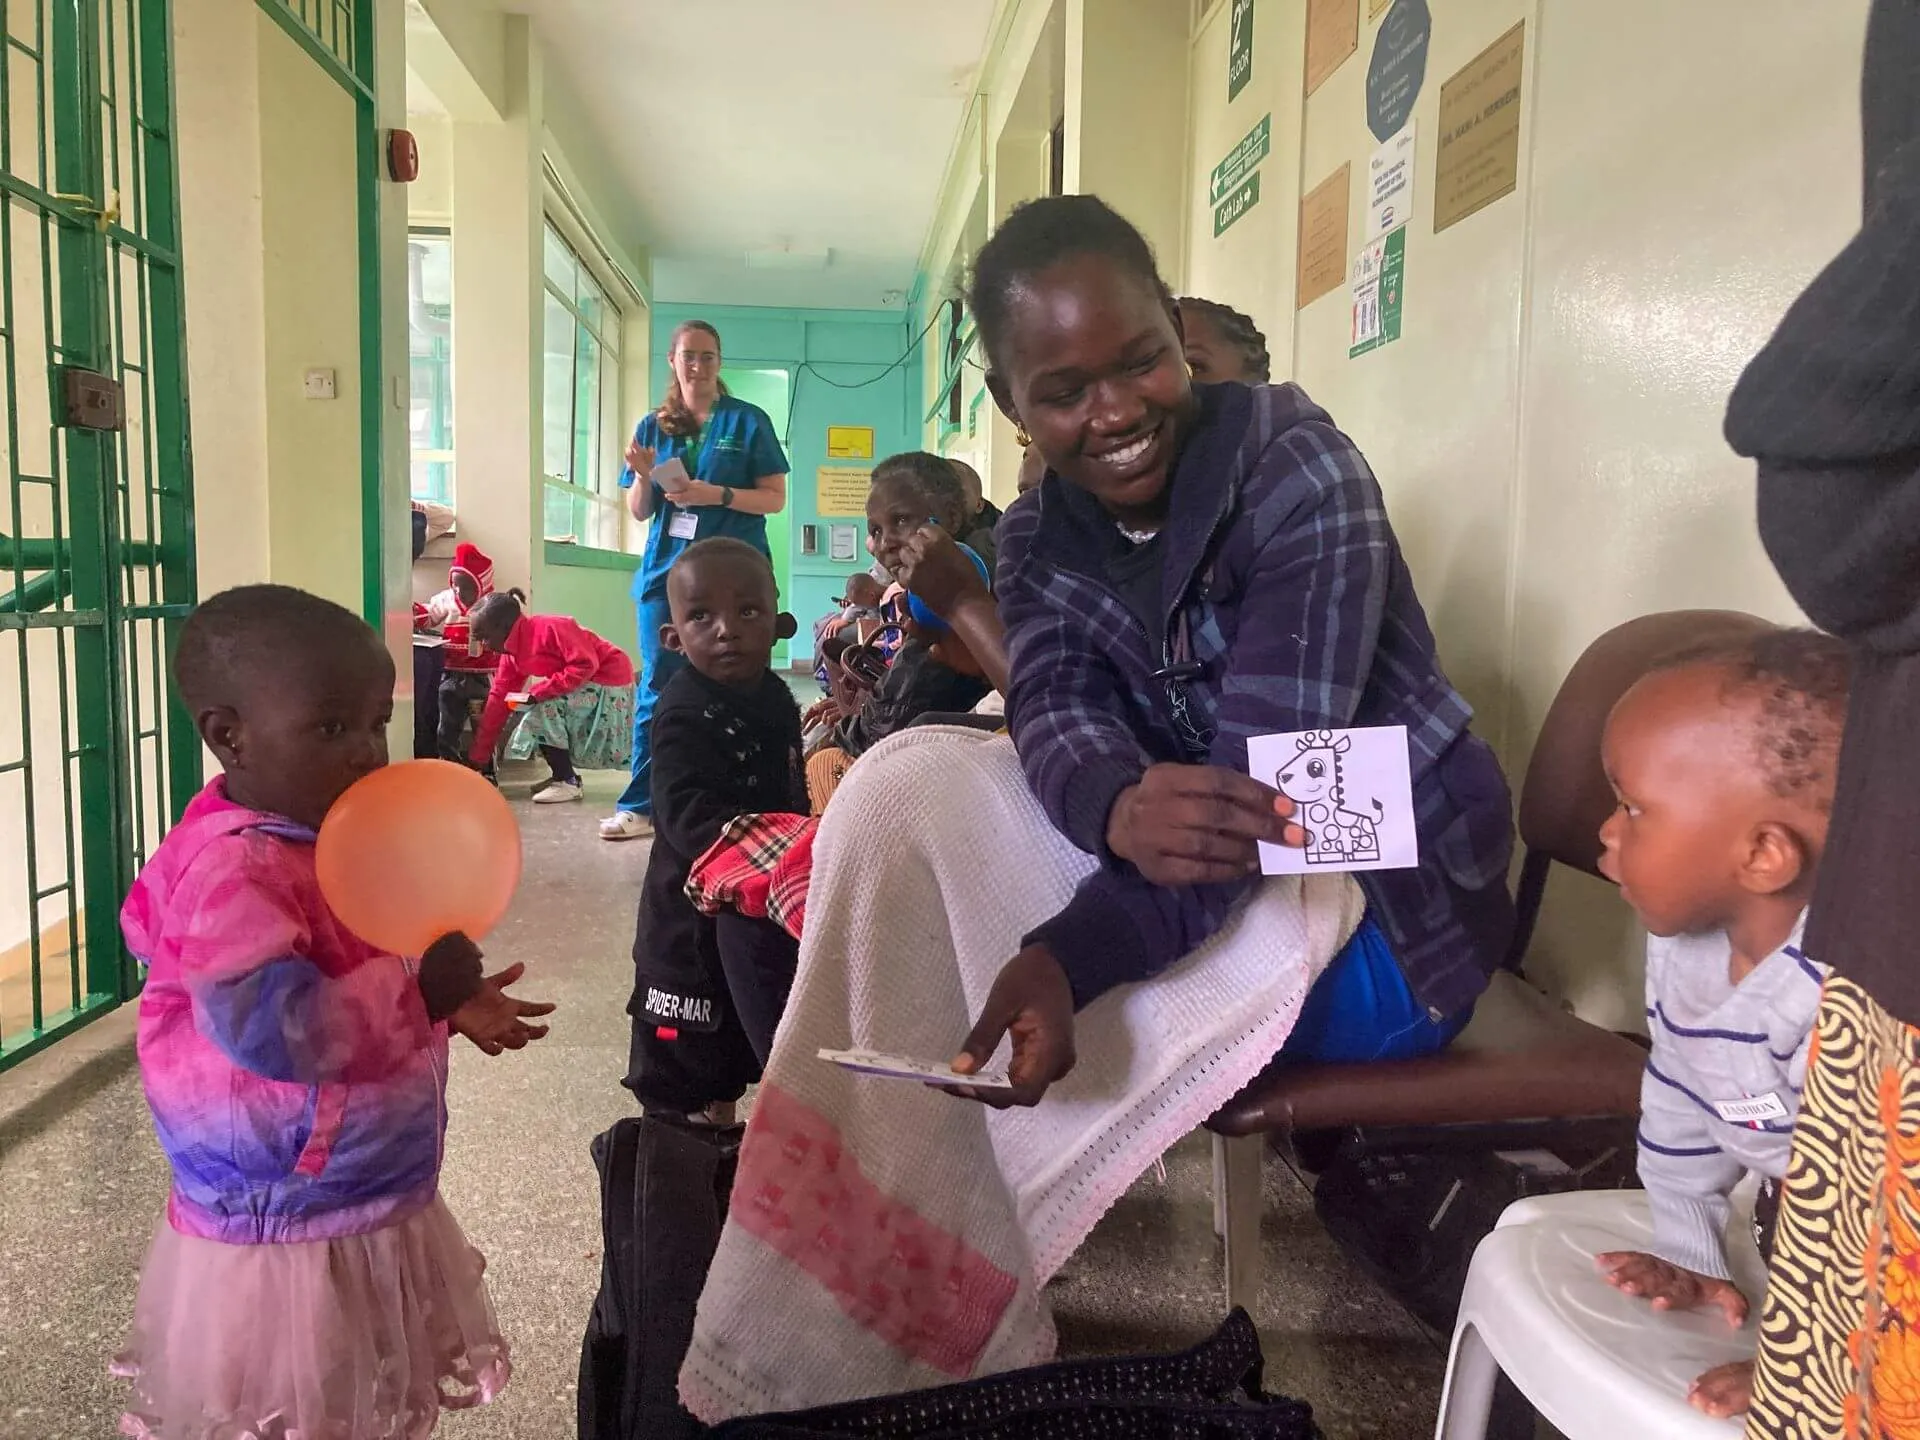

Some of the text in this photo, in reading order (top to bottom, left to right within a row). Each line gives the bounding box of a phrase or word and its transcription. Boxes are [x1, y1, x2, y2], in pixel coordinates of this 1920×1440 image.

[1229, 48, 1249, 86] FLOOR
[1220, 191, 1244, 227] Cath Lab
[1723, 1102, 1777, 1116] FASHION
